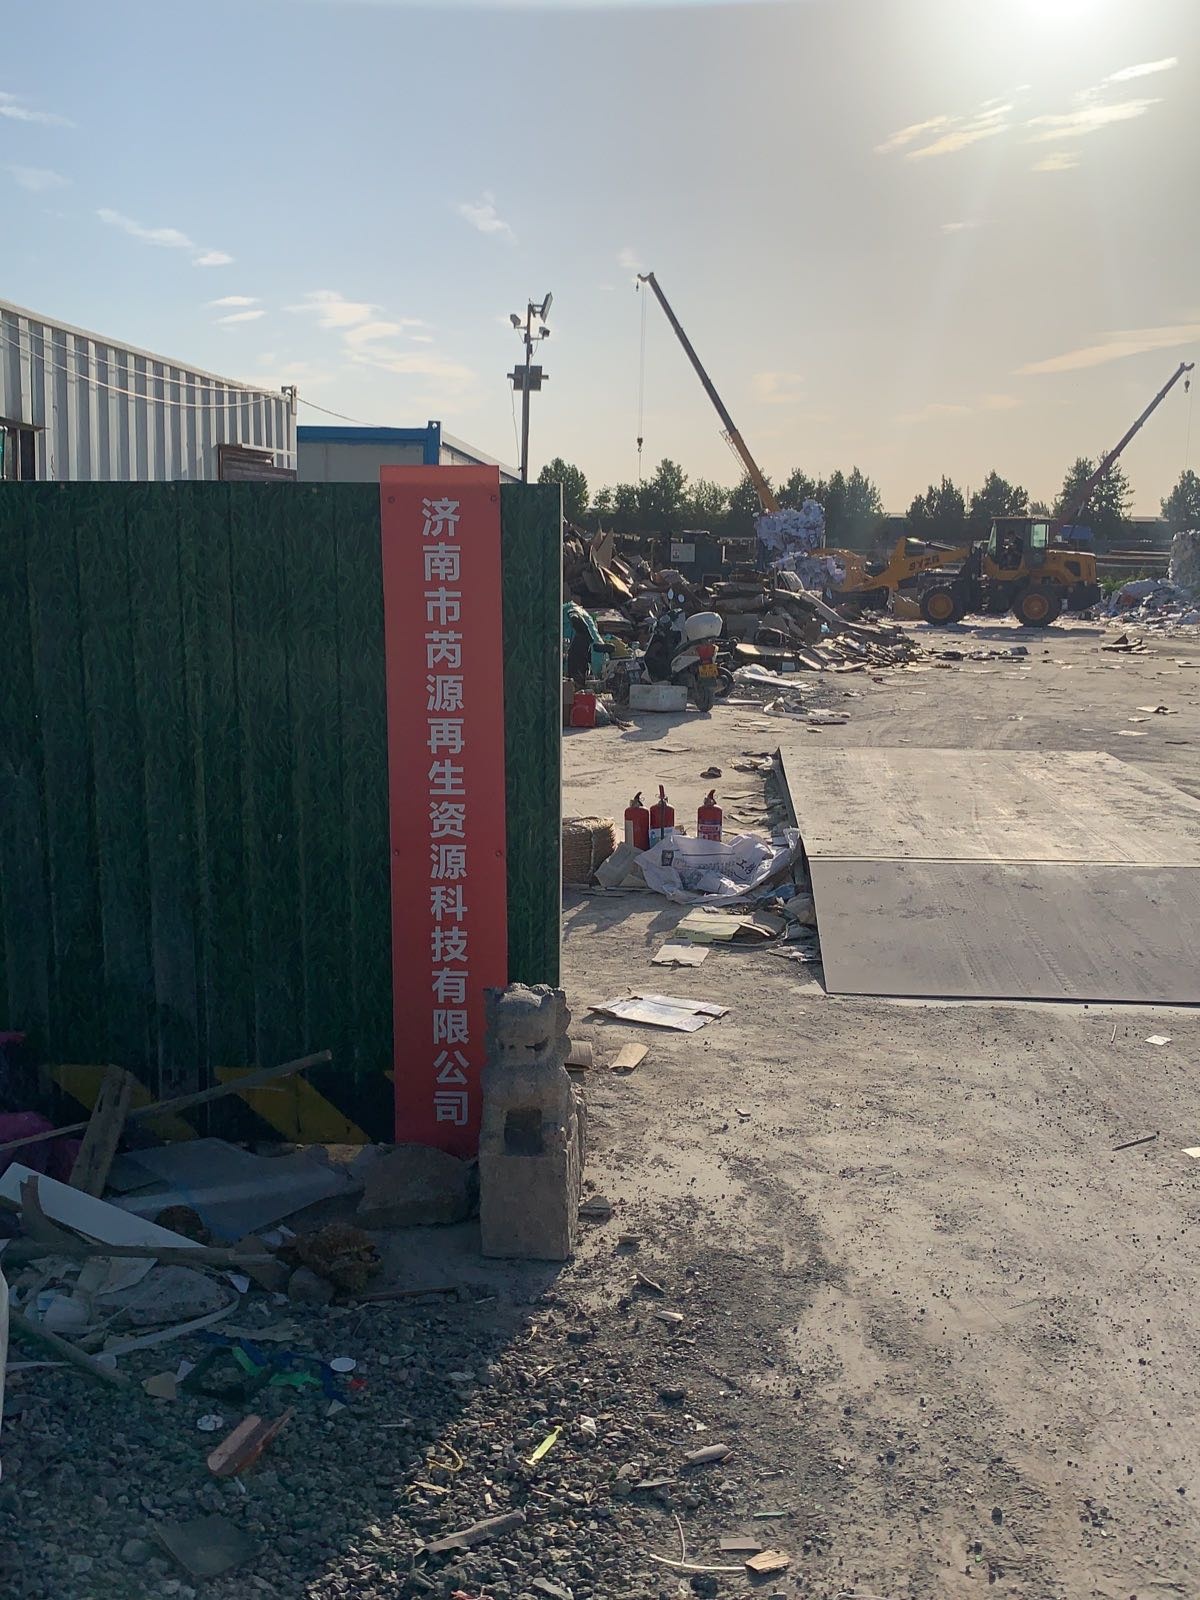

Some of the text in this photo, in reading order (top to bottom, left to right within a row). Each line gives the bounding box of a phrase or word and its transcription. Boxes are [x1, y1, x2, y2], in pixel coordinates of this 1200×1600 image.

[421, 497, 469, 1126] 济南市芮源再生资源科技有限公司
